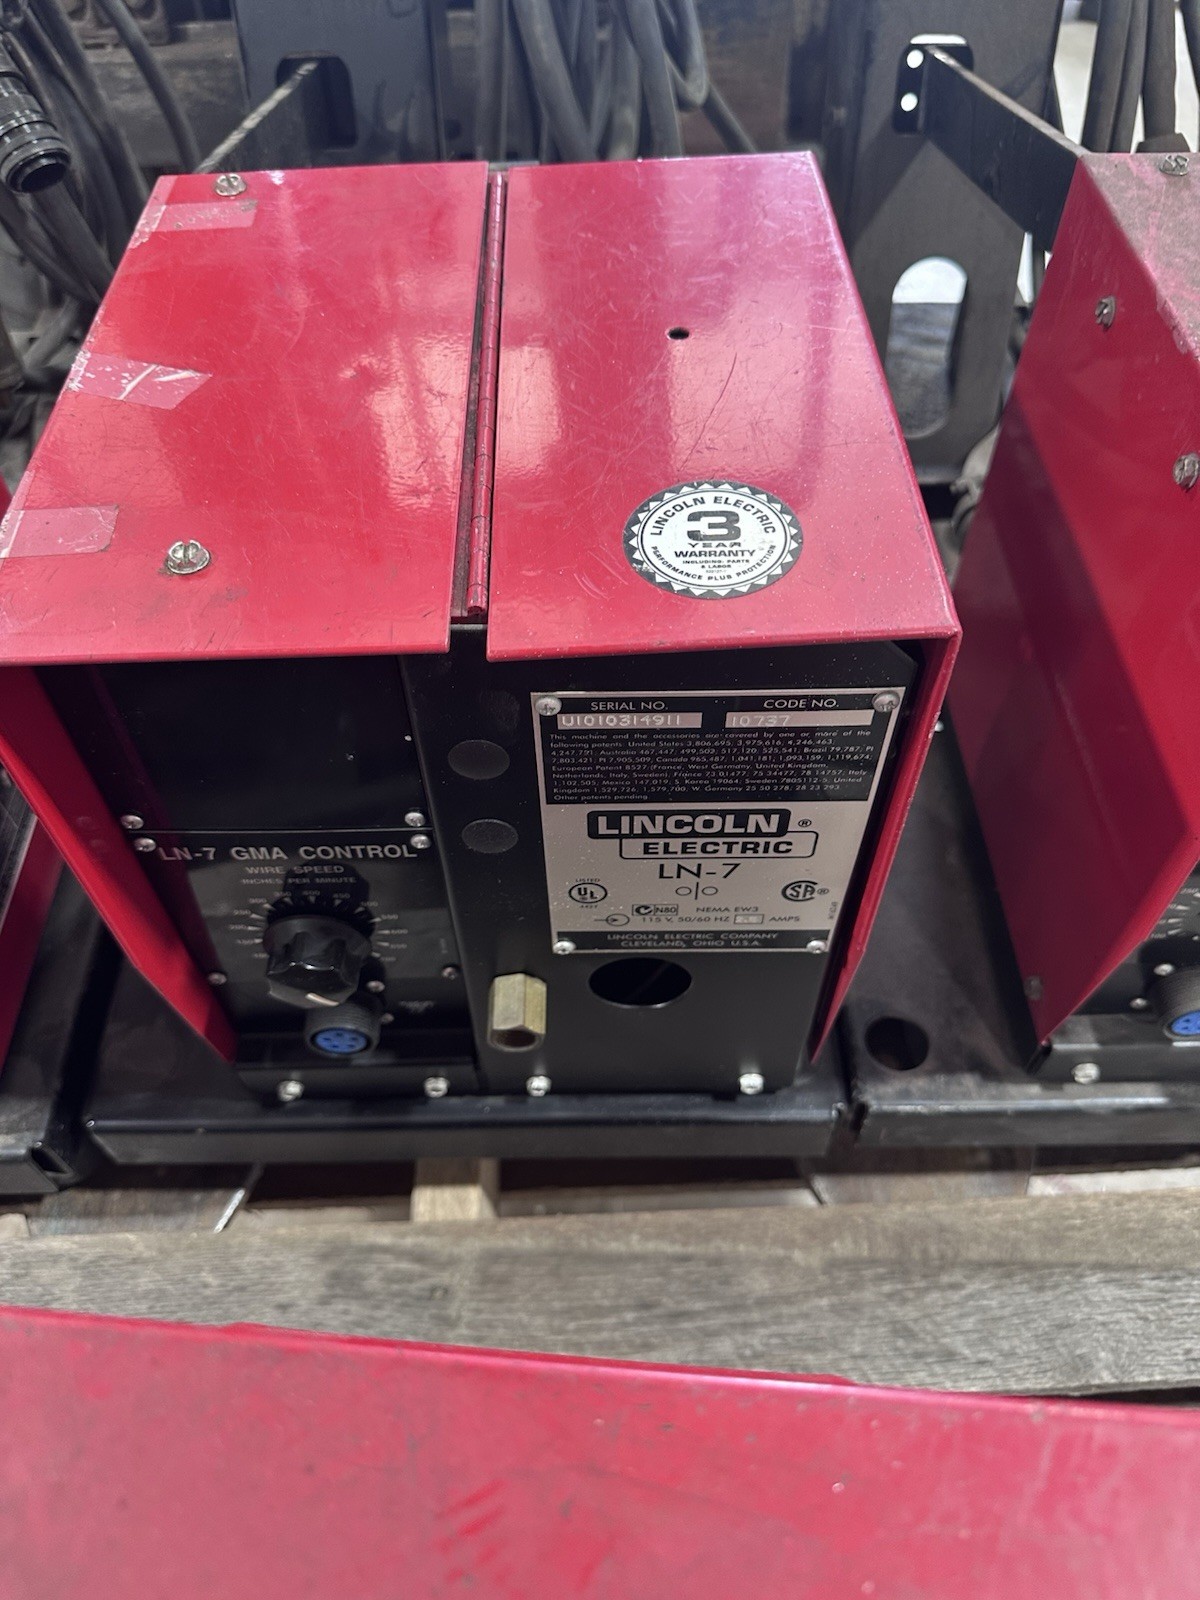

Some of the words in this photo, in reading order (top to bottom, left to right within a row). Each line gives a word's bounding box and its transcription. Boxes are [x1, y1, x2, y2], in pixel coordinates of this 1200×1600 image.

[650, 496, 706, 536] LINCOLN
[713, 496, 776, 534] ELECTRIC
[687, 510, 741, 542] 3
[651, 546, 703, 580] PERFORMANCE
[736, 544, 776, 578] PROTECTION
[674, 550, 756, 558] WARRANTY
[591, 701, 636, 711] SERIAL
[641, 700, 668, 710] NO.
[764, 699, 807, 708] CODE
[811, 698, 840, 708] NO.
[763, 730, 774, 739] by
[597, 814, 780, 835] LINCOLN
[158, 847, 216, 861] LN-7
[230, 846, 289, 860] GMA
[300, 844, 418, 860] CONTROL
[642, 840, 794, 856] ELECTRIC
[246, 866, 286, 874] WIRE
[293, 865, 344, 874] SPEED
[658, 863, 742, 880] LN-7
[655, 906, 677, 914] N80
